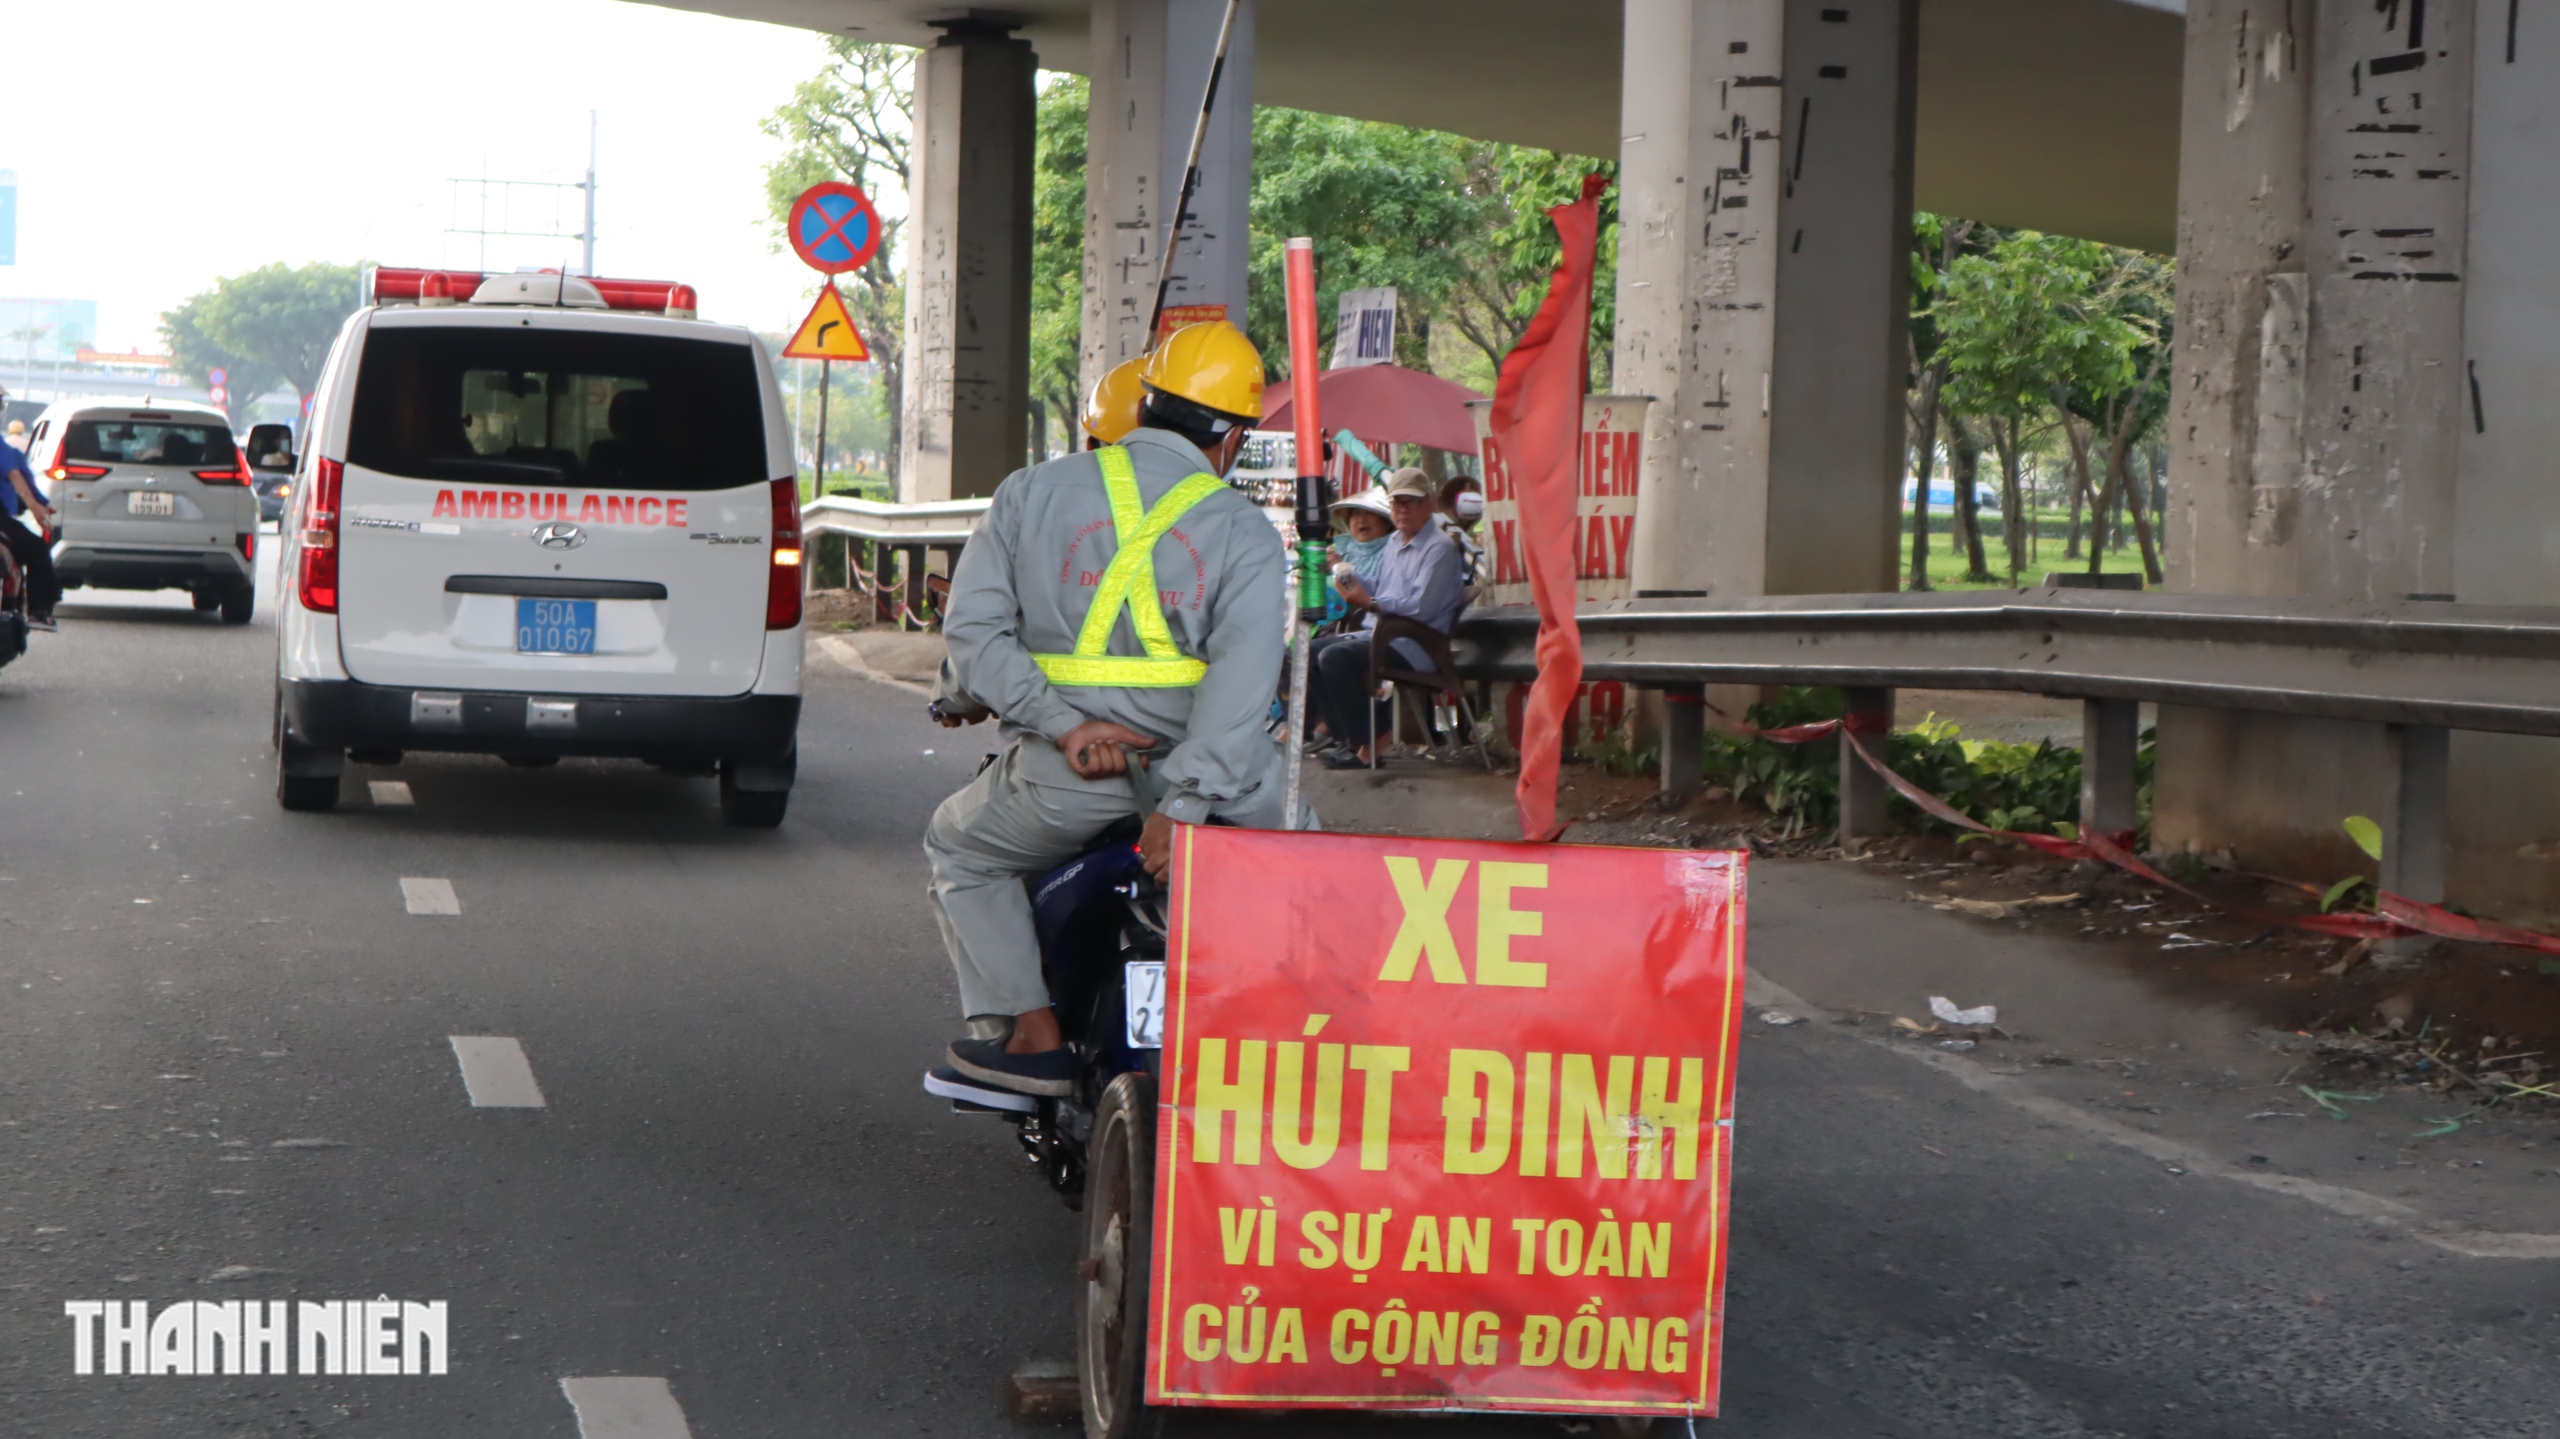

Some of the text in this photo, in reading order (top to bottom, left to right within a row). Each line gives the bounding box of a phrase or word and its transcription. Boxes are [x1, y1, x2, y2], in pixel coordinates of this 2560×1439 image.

[1583, 407, 1640, 497] IỂM
[431, 489, 688, 528] AMBULANCE
[1493, 519, 1529, 585] X
[535, 601, 576, 626] 50A
[1379, 855, 1548, 988] XE
[1192, 1013, 1704, 1181] HÚT ĐINH
[1218, 1196, 1672, 1284] VÌ SỰ AN TOÀN
[1182, 1286, 1689, 1377] CỦA CỘNG ĐỒNG
